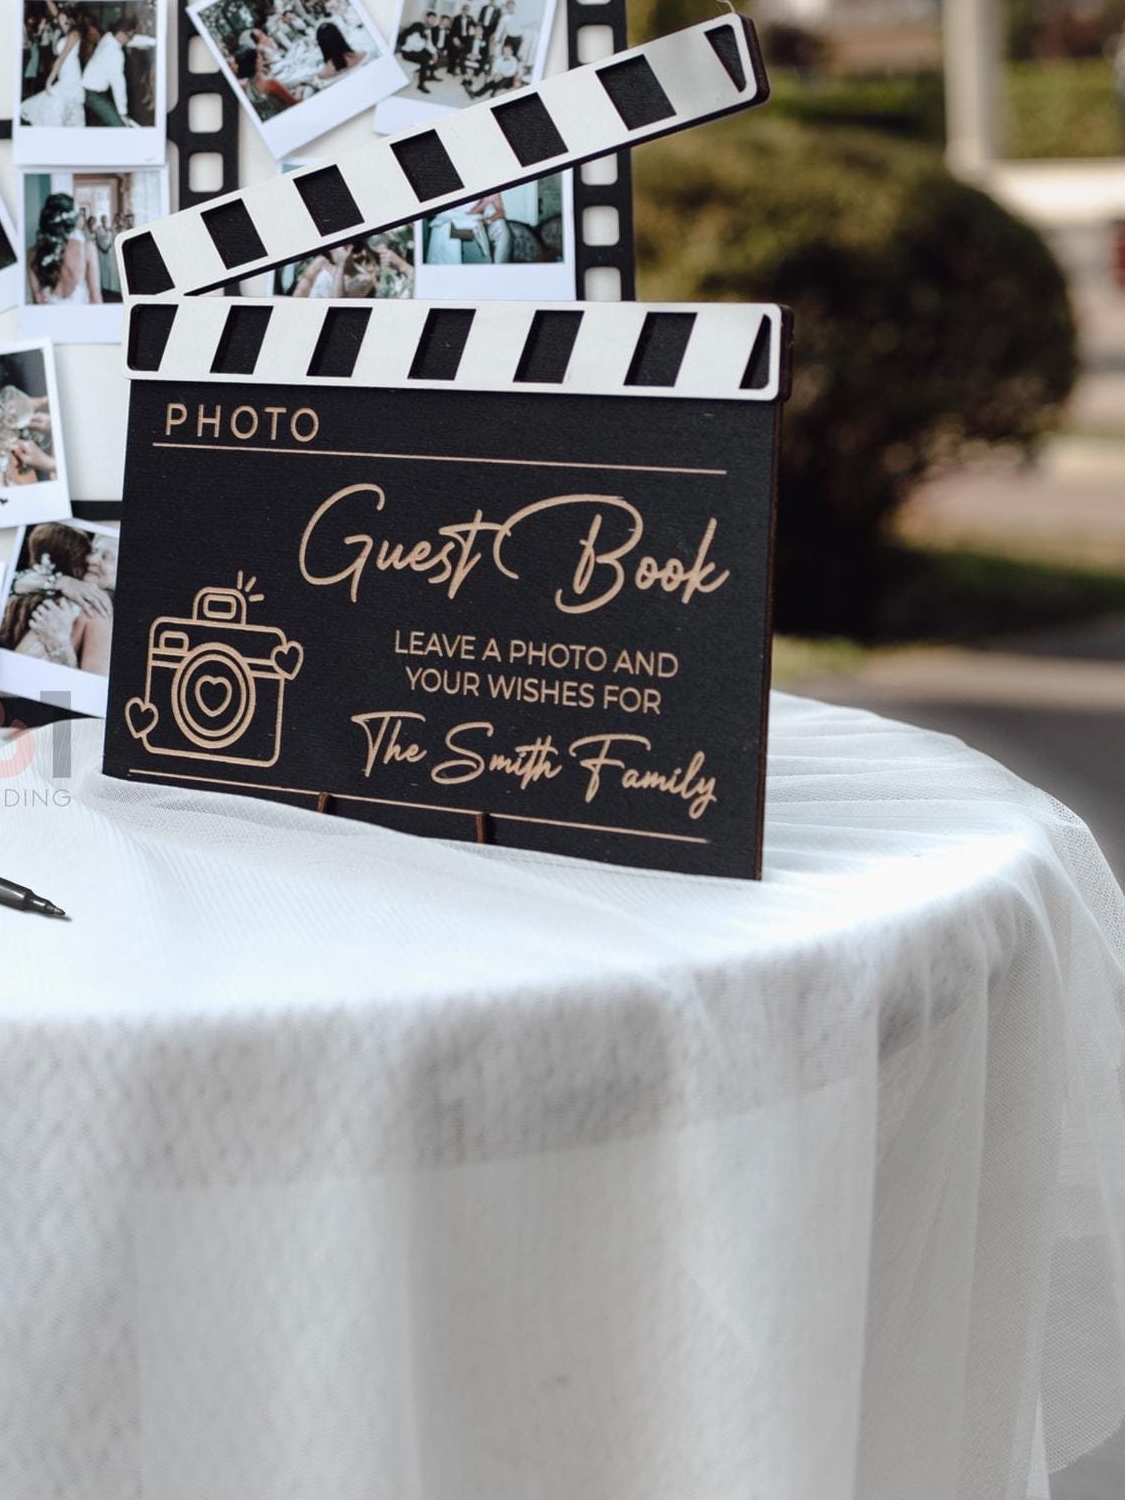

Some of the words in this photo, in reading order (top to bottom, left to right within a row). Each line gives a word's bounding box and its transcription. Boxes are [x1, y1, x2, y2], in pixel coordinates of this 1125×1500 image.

[165, 403, 319, 442] PHOTO
[299, 484, 510, 601] Guest
[492, 494, 730, 613] Book
[394, 631, 475, 659] LEAVE
[481, 638, 501, 660] A
[509, 639, 607, 672] PHOTO
[613, 649, 679, 678] AND
[406, 668, 480, 696] YOUR
[487, 674, 595, 709] WISHES
[603, 684, 662, 715] FOR
[350, 710, 427, 778] The
[430, 721, 563, 790] Smith
[568, 733, 717, 820] Family
